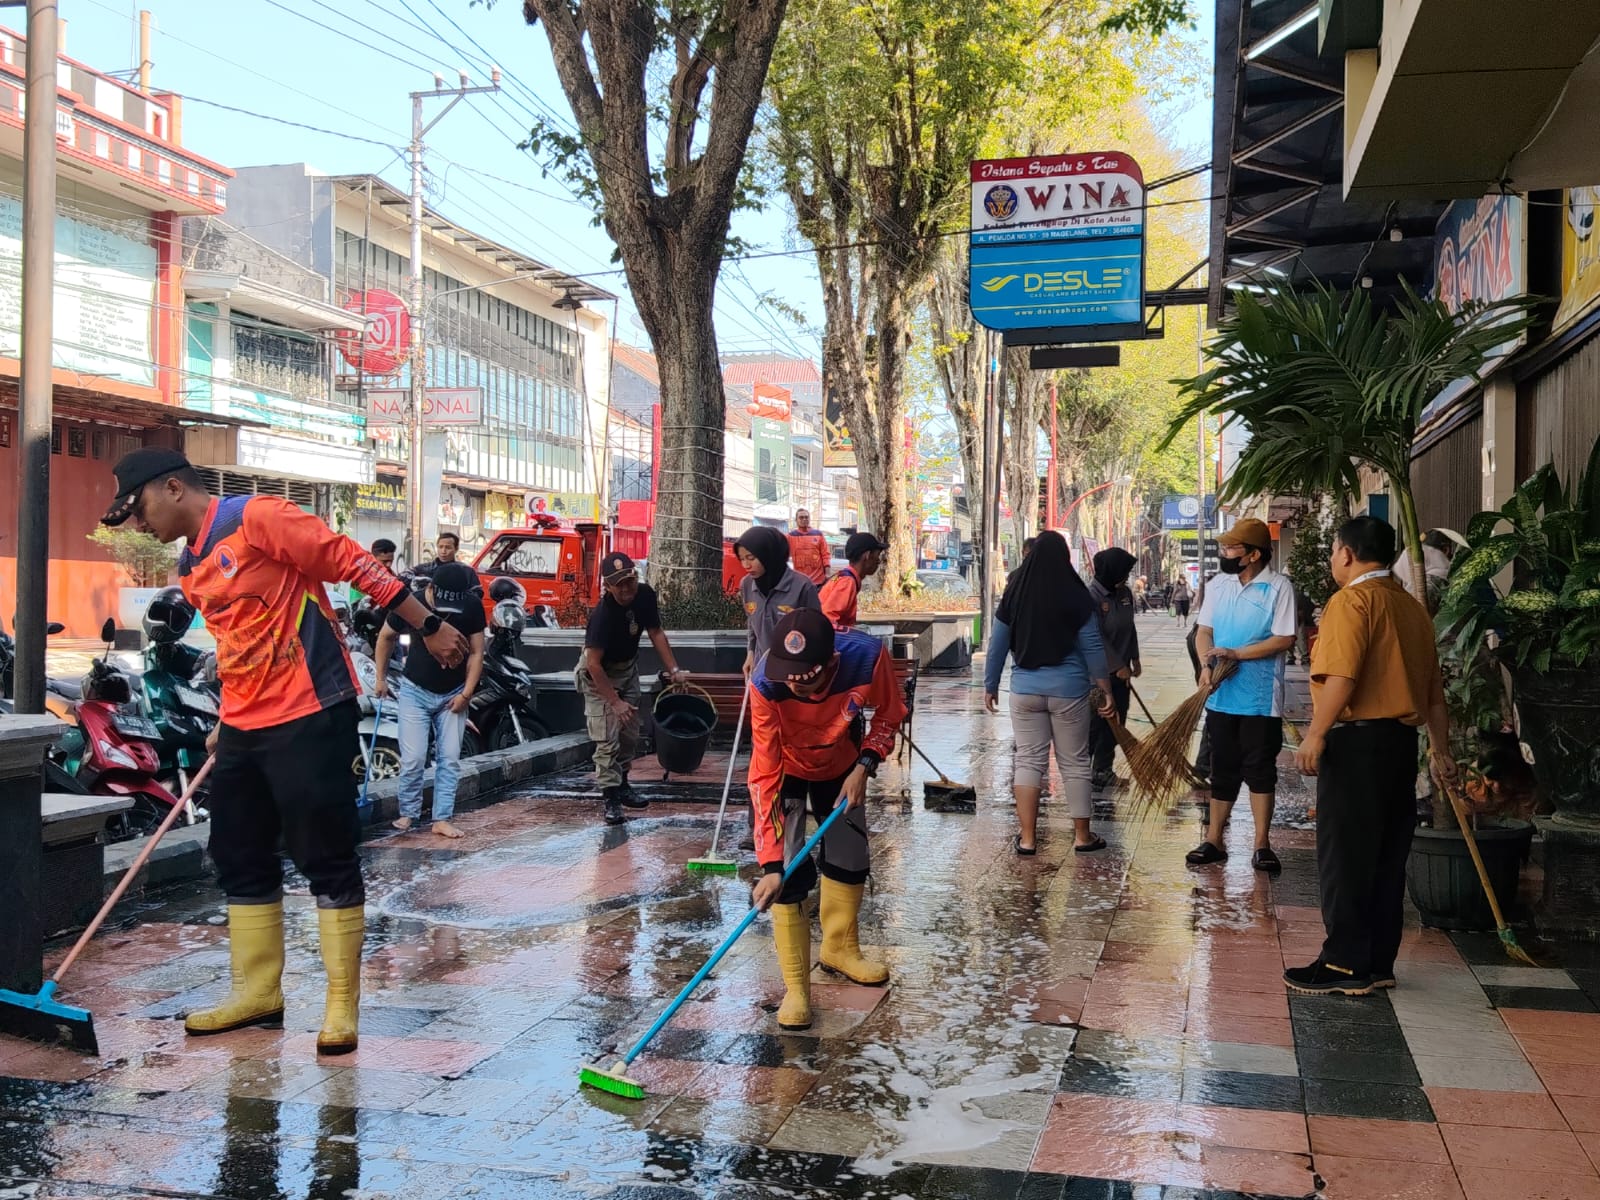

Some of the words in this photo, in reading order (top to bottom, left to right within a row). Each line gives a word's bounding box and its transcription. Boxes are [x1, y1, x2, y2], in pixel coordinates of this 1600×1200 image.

[981, 163, 1024, 178] Istana
[1028, 160, 1072, 176] Sepatu
[1075, 160, 1087, 171] &
[1091, 156, 1119, 170] Tas
[1024, 181, 1132, 211] WINA
[1070, 217, 1081, 225] Di
[1083, 217, 1104, 225] Kota
[1107, 214, 1132, 223] Anda
[988, 233, 1016, 242] PEMUDA
[1024, 268, 1122, 292] DESLE
[373, 397, 475, 415] NAONAL
[356, 481, 395, 499] SEPEDA
[356, 498, 394, 513] SEKARANG
